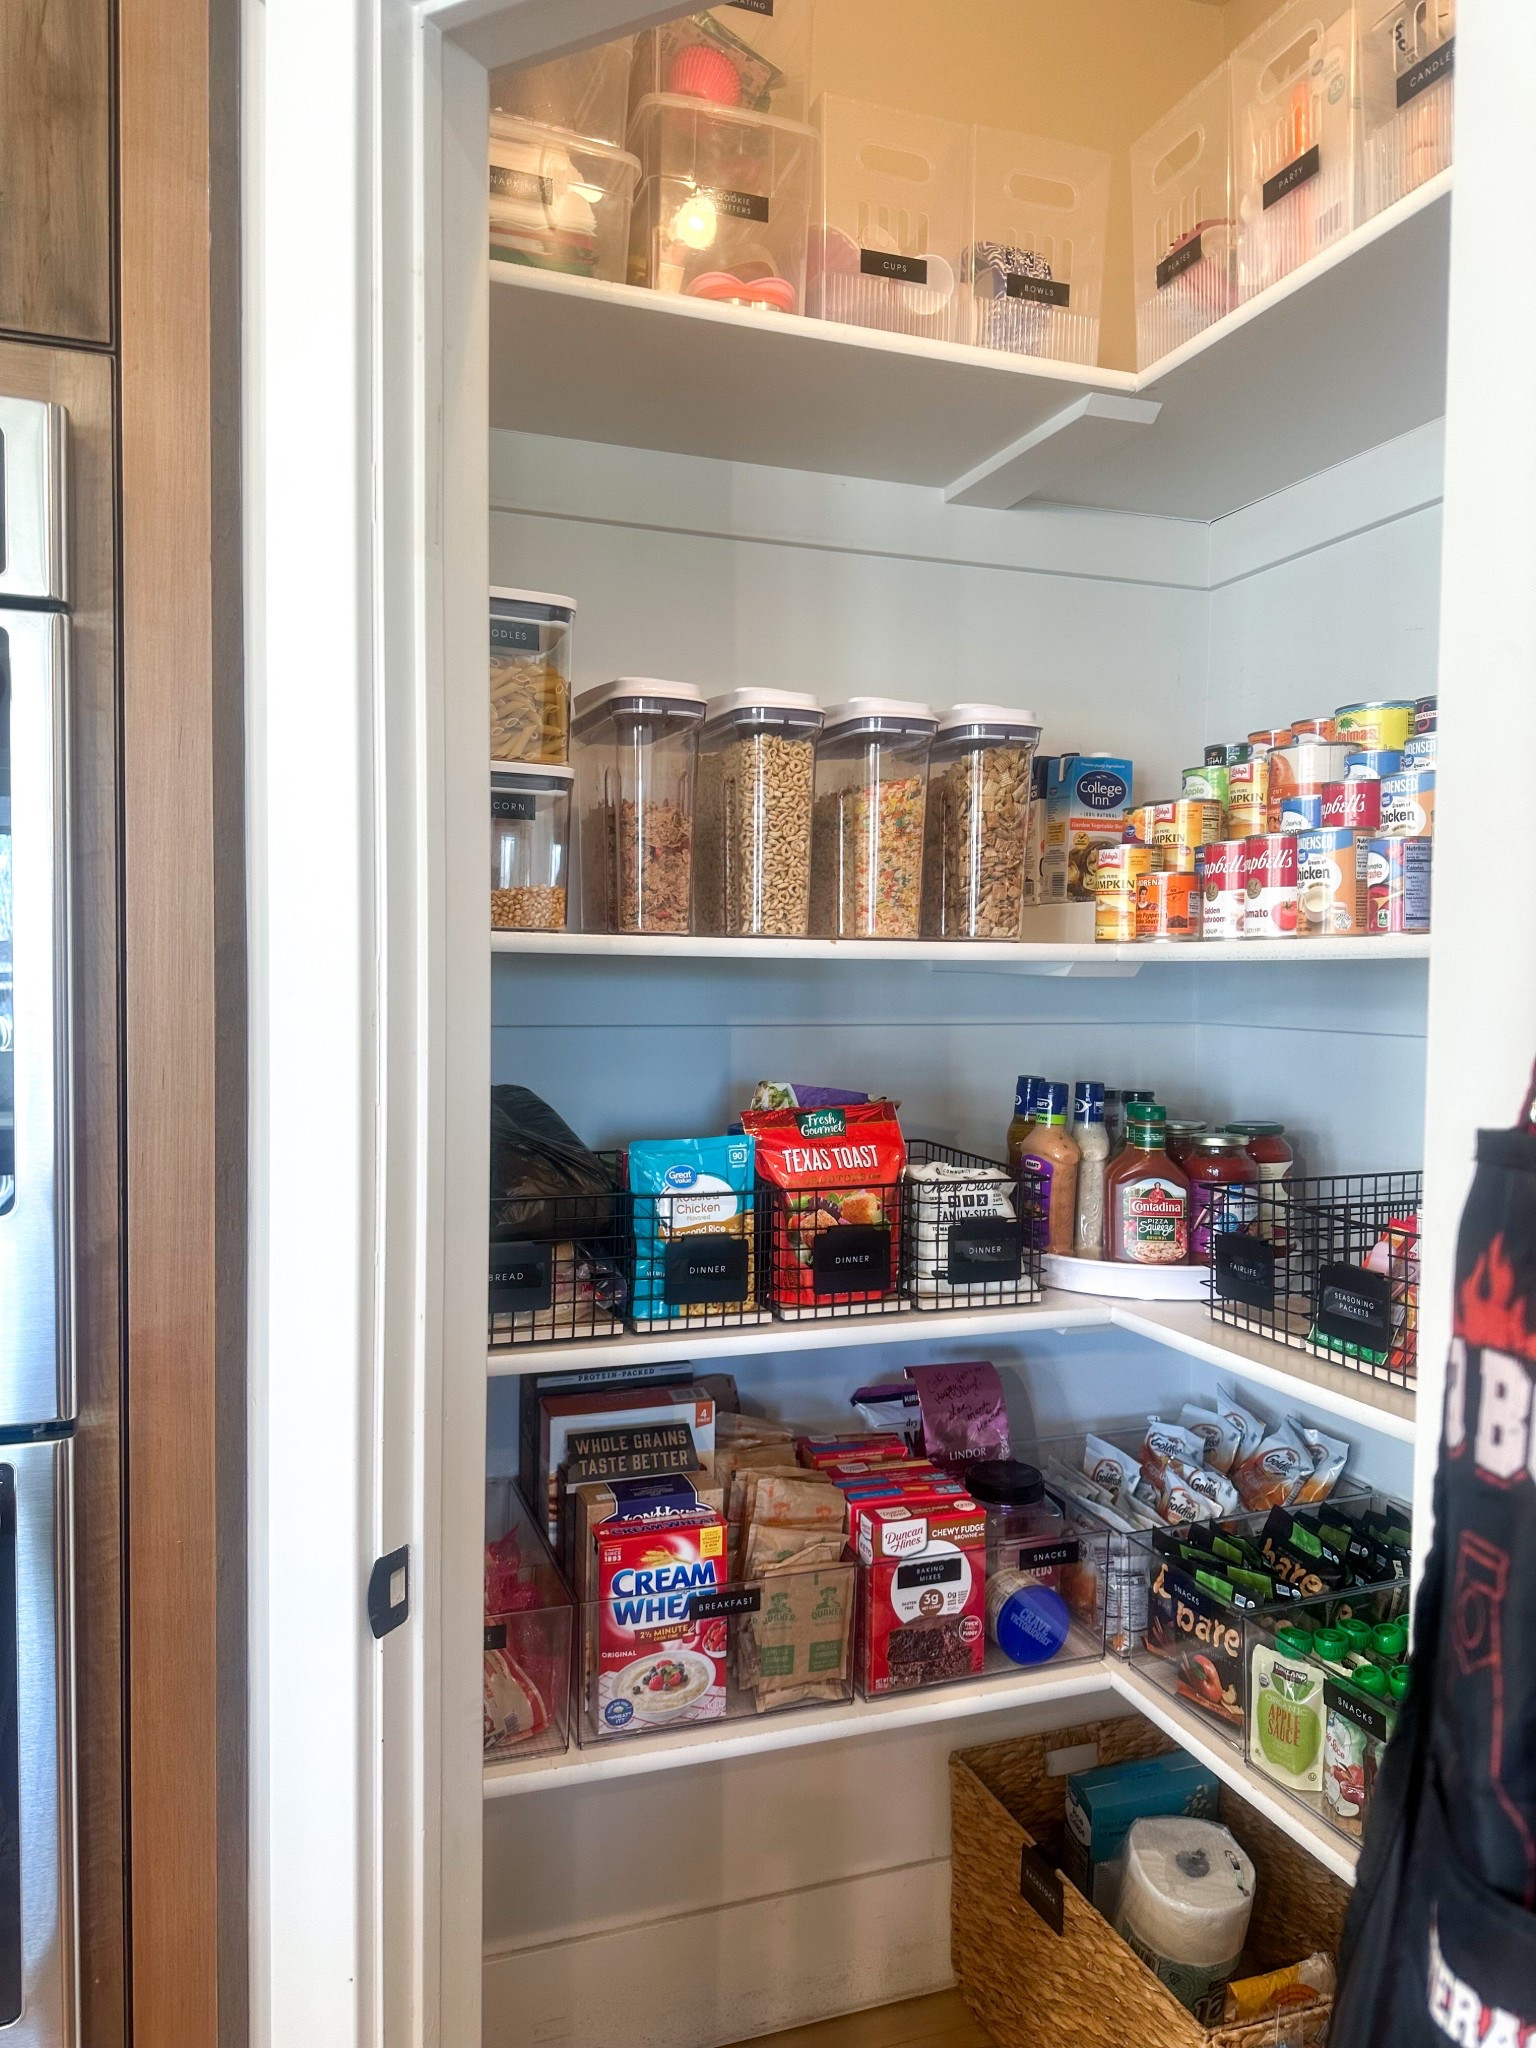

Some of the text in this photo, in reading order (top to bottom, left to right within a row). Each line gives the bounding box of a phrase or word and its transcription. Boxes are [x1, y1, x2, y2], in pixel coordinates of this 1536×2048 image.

[1410, 47, 1456, 87] CANDLES
[1278, 166, 1303, 189] PARTY
[716, 193, 751, 205] COOKIE
[715, 202, 751, 214] CUTTERS
[883, 262, 907, 273] CUPS
[1168, 250, 1191, 273] PLATES
[1024, 284, 1054, 297] BOWLS
[491, 629, 527, 641] ODLES
[1080, 781, 1123, 797] College
[1185, 788, 1204, 797] Apple
[1092, 794, 1109, 806] Inn
[1230, 793, 1264, 804] MPKIN
[493, 801, 525, 812] CORN
[1071, 822, 1090, 830] Garden
[1381, 824, 1390, 833] OUP
[1153, 833, 1186, 843] MPKIN
[805, 1112, 837, 1127] Fresh
[801, 1121, 845, 1136] Gourmet
[732, 1152, 743, 1160] 90
[782, 1145, 878, 1173] TEXAS TOAST
[669, 1171, 692, 1180] Great
[676, 1202, 720, 1215] Chicken
[1131, 1201, 1181, 1213] Contadina
[708, 1224, 726, 1233] Rice
[1138, 1221, 1175, 1237] Squeeze
[969, 1246, 1001, 1254] DINNER
[835, 1255, 870, 1264] DINNER
[690, 1266, 726, 1274] DINNER
[1229, 1262, 1257, 1277] FAIRLIFE
[489, 1272, 524, 1282] BREAD
[1334, 1292, 1374, 1310] SEASONING
[1339, 1302, 1369, 1318] PACKETS
[577, 1368, 655, 1382] PROTEIN-PACKED
[700, 1408, 707, 1417] 4
[906, 1419, 918, 1428] dry
[575, 1429, 687, 1455] WHOLE GRAINS
[949, 1447, 986, 1460] LINDOR
[579, 1450, 689, 1476] TASTE BETTER
[1096, 1470, 1122, 1487] Goldfish
[611, 1518, 715, 1535] CREAM WHEAT
[931, 1523, 984, 1537] CHEWY FUDGE
[885, 1526, 923, 1544] Duncan
[954, 1532, 977, 1540] BROWNIE
[859, 1542, 871, 1557] KETO
[890, 1536, 921, 1552] Hines
[1034, 1550, 1067, 1561] SNACKS
[917, 1565, 944, 1575] BAKING
[612, 1561, 716, 1597] CREAM
[923, 1594, 939, 1604] 3g
[1173, 1583, 1200, 1606] SNACKS
[699, 1597, 753, 1611] BREAKFAST
[1020, 1608, 1051, 1635] CRAVE
[654, 1624, 689, 1637] MINUTE
[1011, 1612, 1053, 1646] VICTORIOUSLY
[1176, 1600, 1240, 1658] bare
[602, 1650, 637, 1658] ORIGINAL
[1265, 1694, 1308, 1716] ORGANIC
[1337, 1697, 1373, 1725] SNACKS
[1268, 1704, 1300, 1731] APPLE
[1267, 1719, 1300, 1746] SAUCE
[1330, 1739, 1345, 1759] Sauce
[1025, 1870, 1056, 1905] BACKSTOCK
